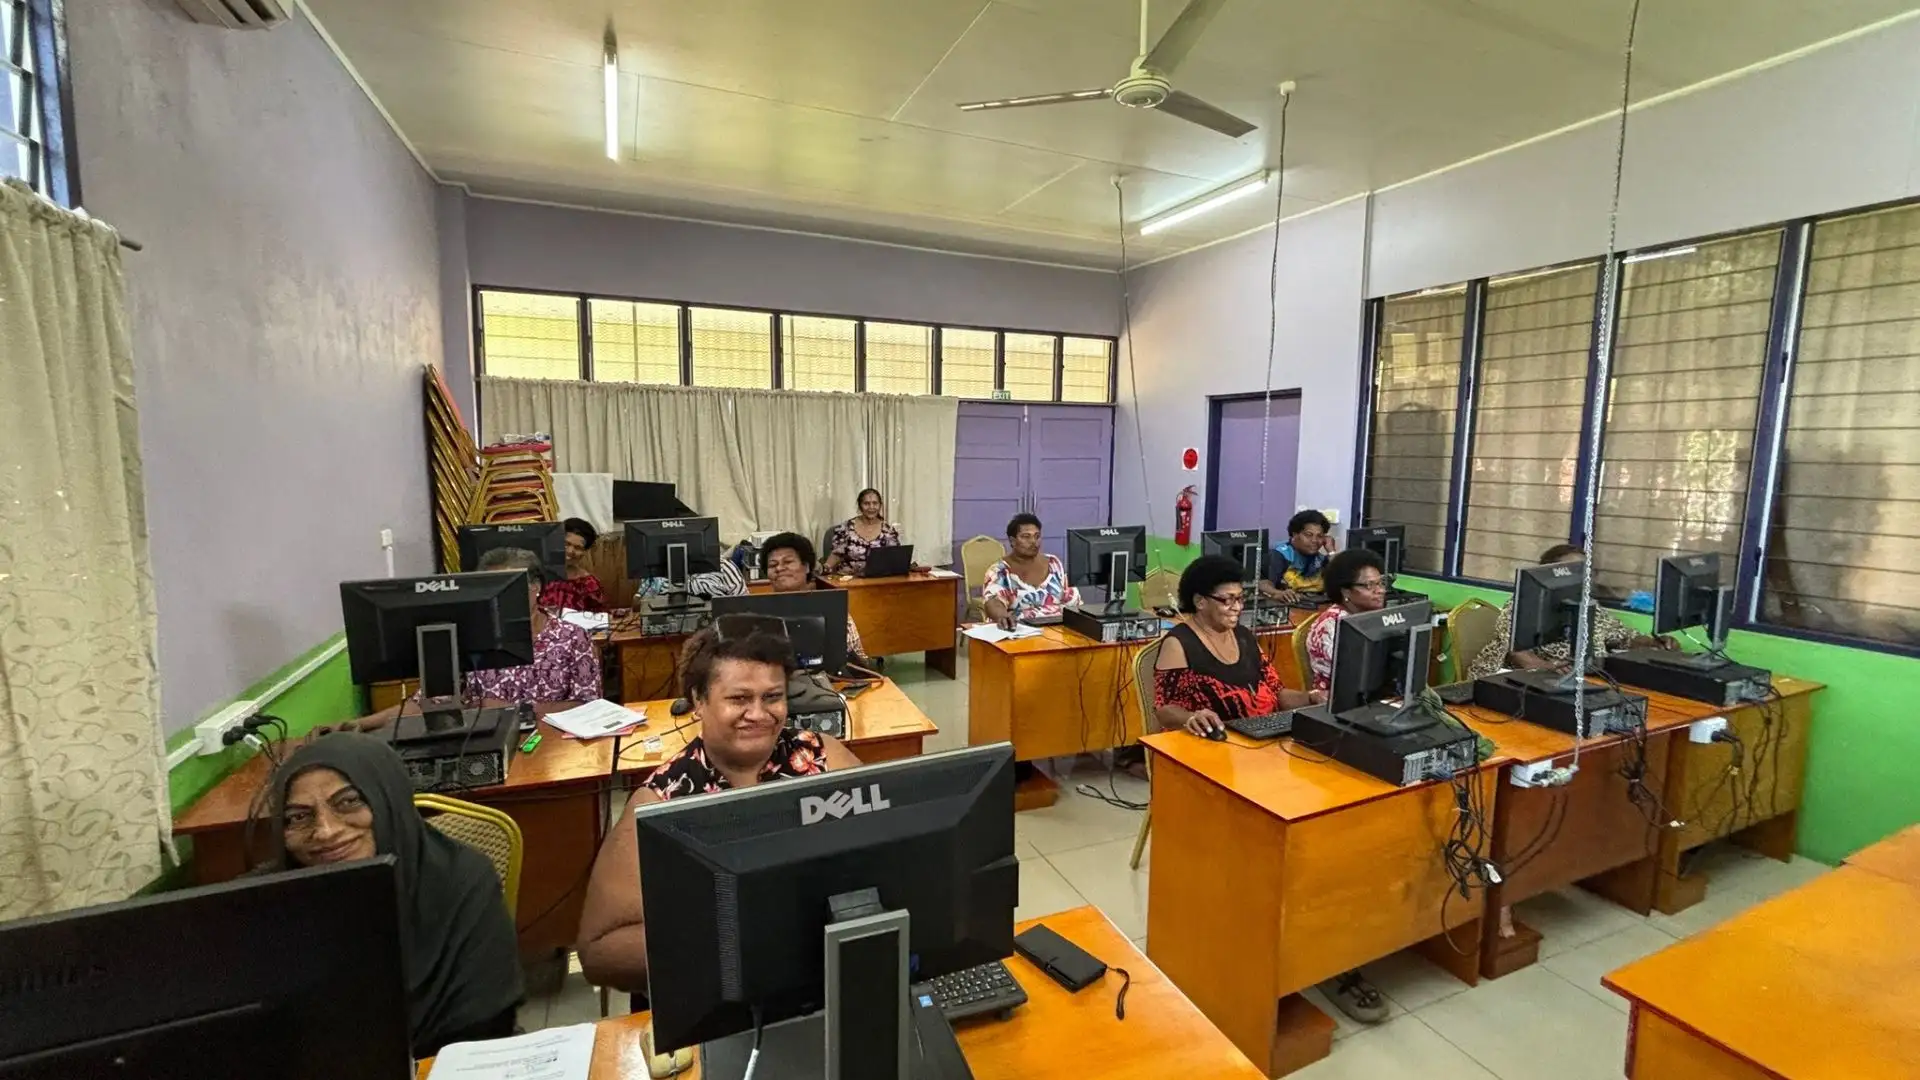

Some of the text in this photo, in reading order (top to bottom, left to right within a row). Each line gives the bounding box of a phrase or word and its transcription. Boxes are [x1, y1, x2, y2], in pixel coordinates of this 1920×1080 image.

[993, 392, 1010, 400] EXIT
[1100, 528, 1119, 536] DELL
[415, 579, 460, 593] DELL
[1382, 612, 1406, 627] DELL
[800, 783, 890, 826] DELL
